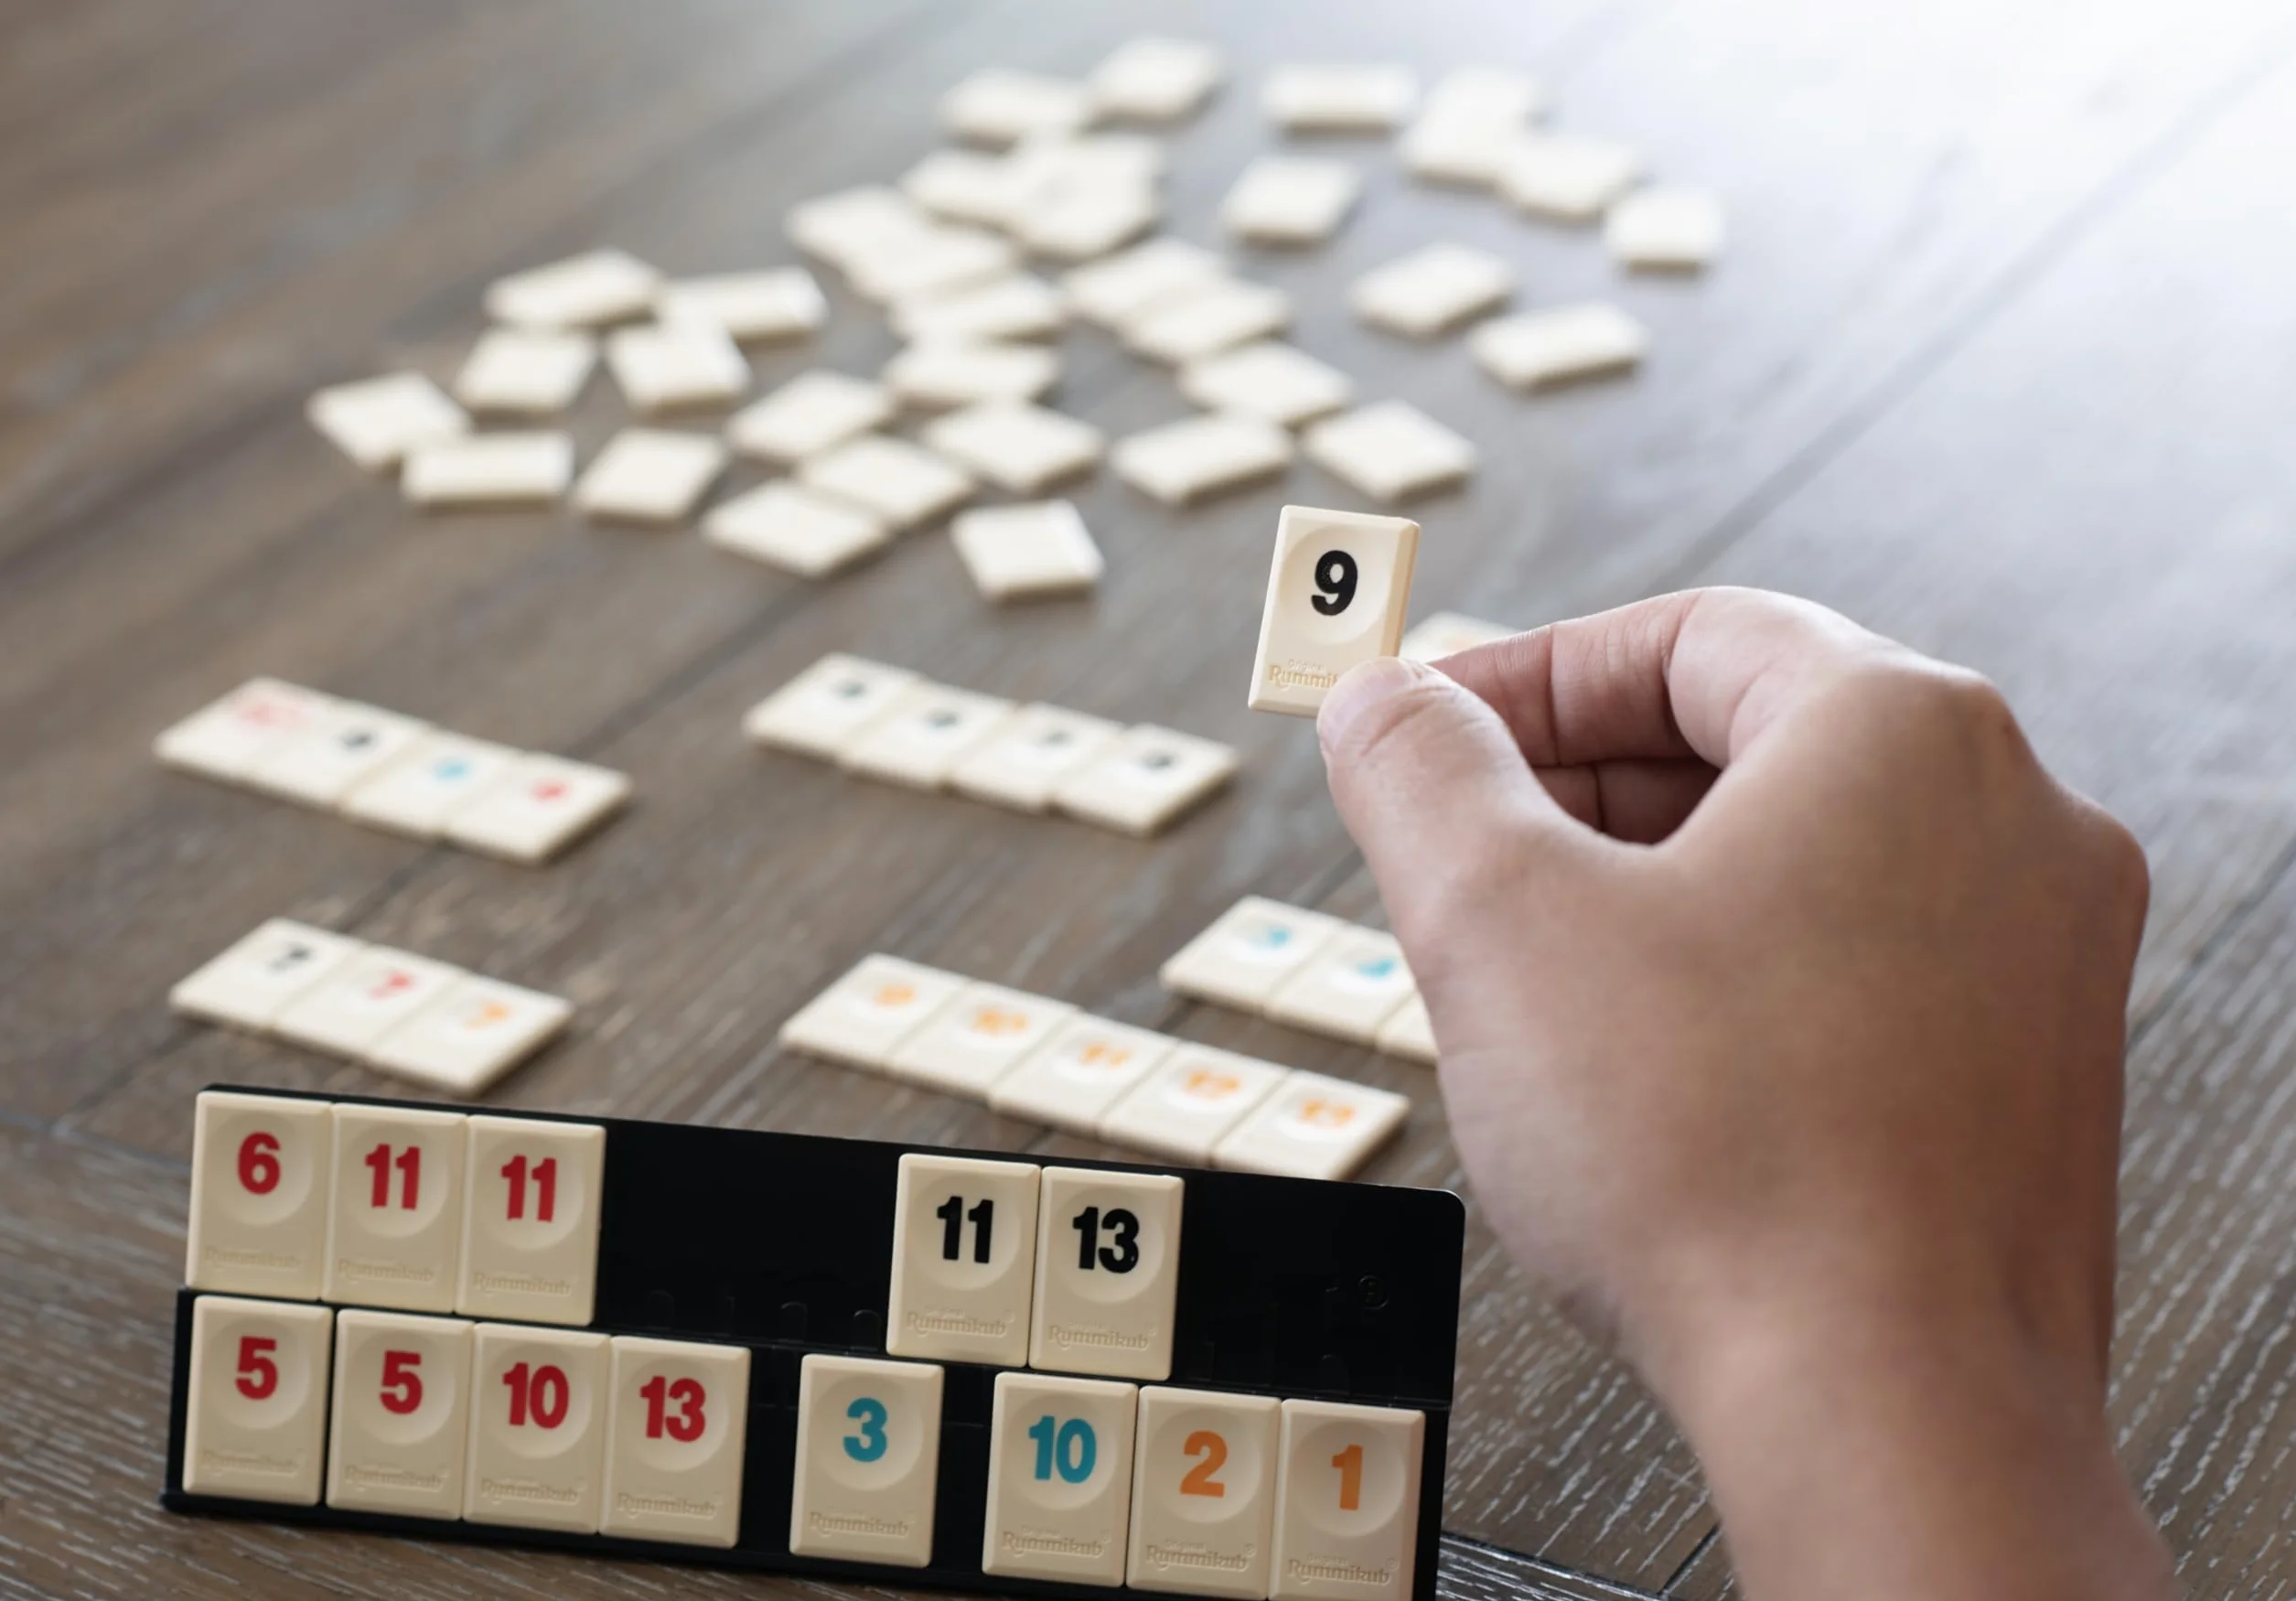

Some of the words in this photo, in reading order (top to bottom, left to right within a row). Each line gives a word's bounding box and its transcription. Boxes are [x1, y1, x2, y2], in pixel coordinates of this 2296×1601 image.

[1311, 550, 1358, 616] 9
[1266, 663, 1339, 692] Rummi
[238, 1132, 280, 1194] 6
[365, 1144, 420, 1209] 11
[501, 1155, 556, 1222] 11
[936, 1195, 994, 1264] 11
[1071, 1206, 1140, 1274] 13
[907, 1310, 1006, 1338] Rummikub
[1048, 1325, 1150, 1350] Rummikub
[236, 1336, 278, 1401] 5
[380, 1350, 423, 1414] 5
[502, 1362, 569, 1429] 10
[639, 1375, 705, 1442] 13
[842, 1398, 888, 1463] 3
[1029, 1415, 1096, 1484] 10
[1180, 1430, 1228, 1498] 2
[1331, 1444, 1363, 1510] 1
[810, 1511, 909, 1538] Rummikub
[1002, 1531, 1104, 1557] Rummikub
[1145, 1544, 1249, 1572] Rummikub
[1288, 1559, 1390, 1585] Rummikub
